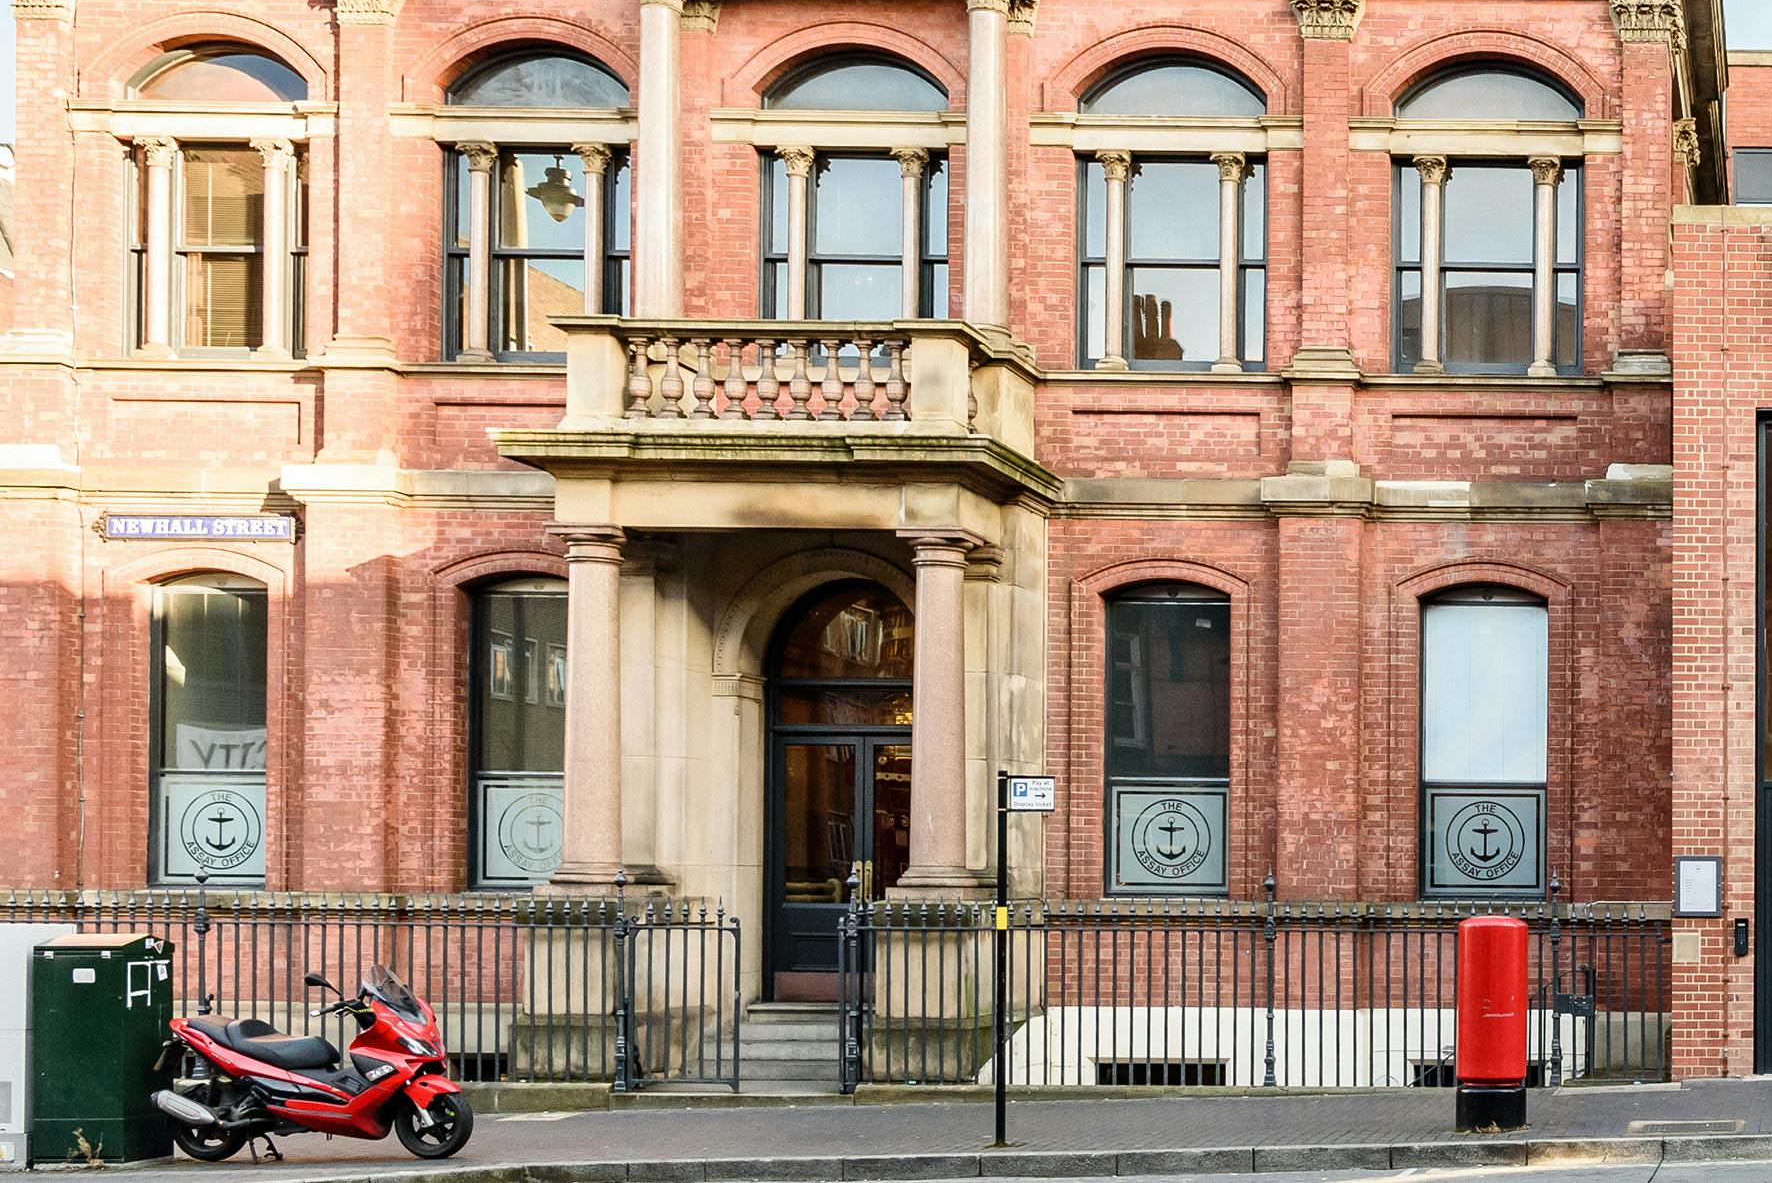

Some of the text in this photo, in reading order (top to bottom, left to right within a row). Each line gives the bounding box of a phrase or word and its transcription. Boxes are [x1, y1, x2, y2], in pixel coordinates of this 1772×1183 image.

[111, 518, 287, 535] NEWHALL STREET
[212, 793, 232, 803] THE
[1161, 802, 1183, 812] THE
[1474, 804, 1497, 814] THE
[186, 840, 256, 867] ASSAY OFFICE
[1137, 849, 1205, 876] ASSAY OFFICE
[1452, 850, 1520, 878] ASSAY OFFICE
